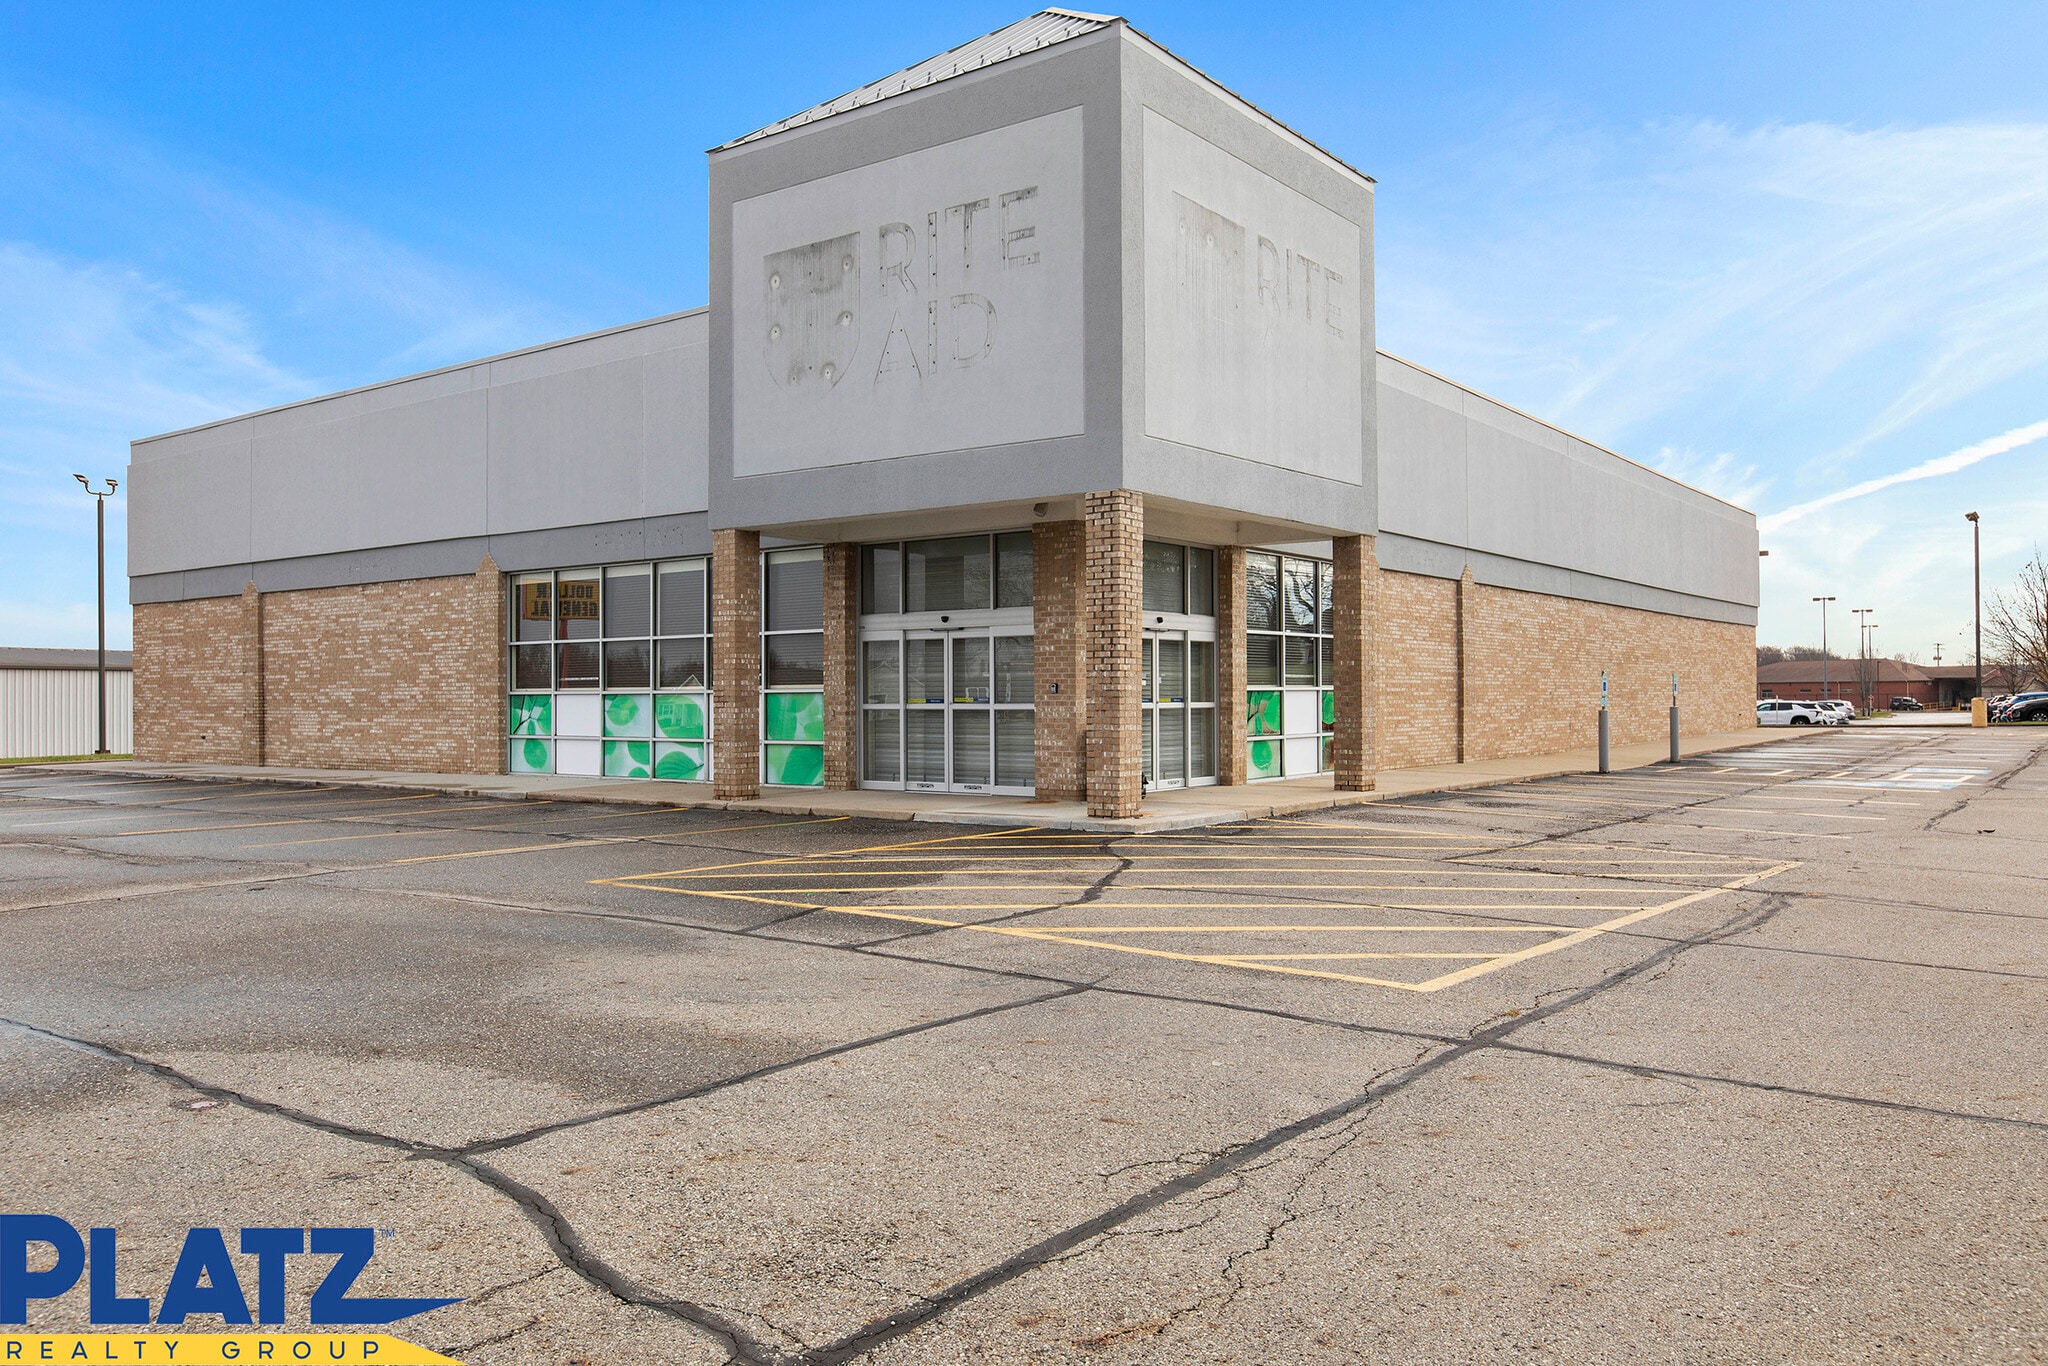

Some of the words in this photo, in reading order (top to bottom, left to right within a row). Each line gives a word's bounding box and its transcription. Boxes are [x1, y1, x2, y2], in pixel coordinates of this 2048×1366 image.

[879, 185, 1040, 297] RITE
[1257, 234, 1344, 339] RITE
[873, 293, 998, 388] AID
